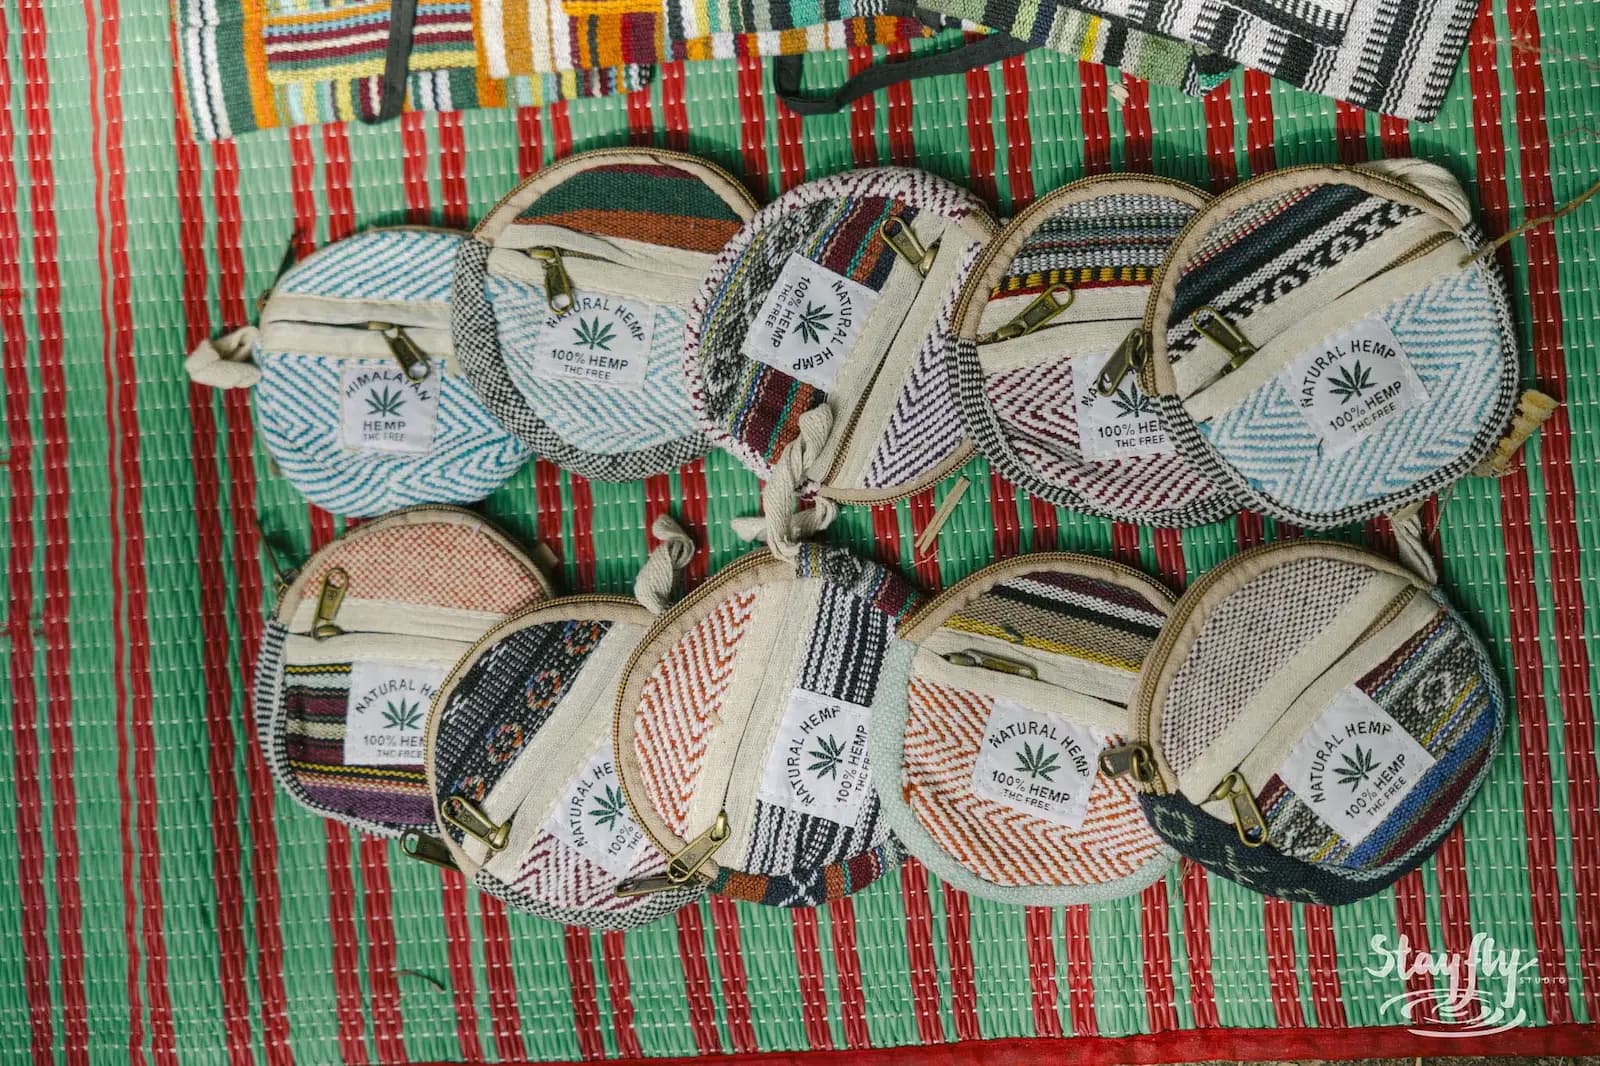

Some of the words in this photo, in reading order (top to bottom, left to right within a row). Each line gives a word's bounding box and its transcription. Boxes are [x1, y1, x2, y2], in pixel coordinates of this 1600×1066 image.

[777, 283, 793, 303] THC
[788, 276, 811, 308] 100%
[614, 304, 646, 341] HEMP
[765, 303, 782, 329] FREE
[831, 279, 852, 345] NATURAL
[770, 308, 795, 348] HEMP
[551, 348, 585, 365] 100%
[588, 355, 629, 371] HEMP
[564, 364, 583, 376] THC
[586, 368, 611, 380] FREE
[792, 346, 834, 370] HEMP
[345, 370, 431, 401] HIMALAAN
[1300, 345, 1346, 409] NATURAL
[1351, 339, 1396, 359] HEMP
[1329, 405, 1366, 431] 100%
[1364, 380, 1402, 411] HEMP
[1351, 417, 1371, 433] THC
[1372, 402, 1396, 422] FREE
[363, 420, 406, 431] HEMP
[1098, 423, 1135, 438] 100%
[1138, 419, 1162, 433] HE
[1115, 439, 1136, 449] THC
[1139, 434, 1165, 446] FREE
[355, 678, 416, 714] NATURAL
[420, 682, 438, 700] HE
[363, 735, 397, 747] 100%
[400, 735, 424, 747] HE
[377, 749, 397, 758] THC
[988, 721, 1058, 749] NATURAL
[1060, 735, 1090, 778] HEMP
[787, 738, 815, 807] NATURAL
[836, 769, 857, 803] 100%
[848, 724, 868, 766] HEMP
[1310, 734, 1344, 804] NATURAL
[1344, 721, 1392, 738] HEMP
[855, 772, 868, 792] THC
[992, 769, 1026, 792] 100%
[1028, 783, 1071, 804] HEMP
[1345, 788, 1378, 819] 100%
[1373, 753, 1406, 791] HEMP
[1366, 797, 1386, 817] THC
[1384, 775, 1407, 800] FREE
[570, 780, 594, 848] NATURAL
[592, 761, 614, 779] HE
[1003, 788, 1023, 802] THC
[1025, 796, 1051, 811] FREE
[608, 825, 634, 856] 100%
[627, 831, 643, 850] THC
